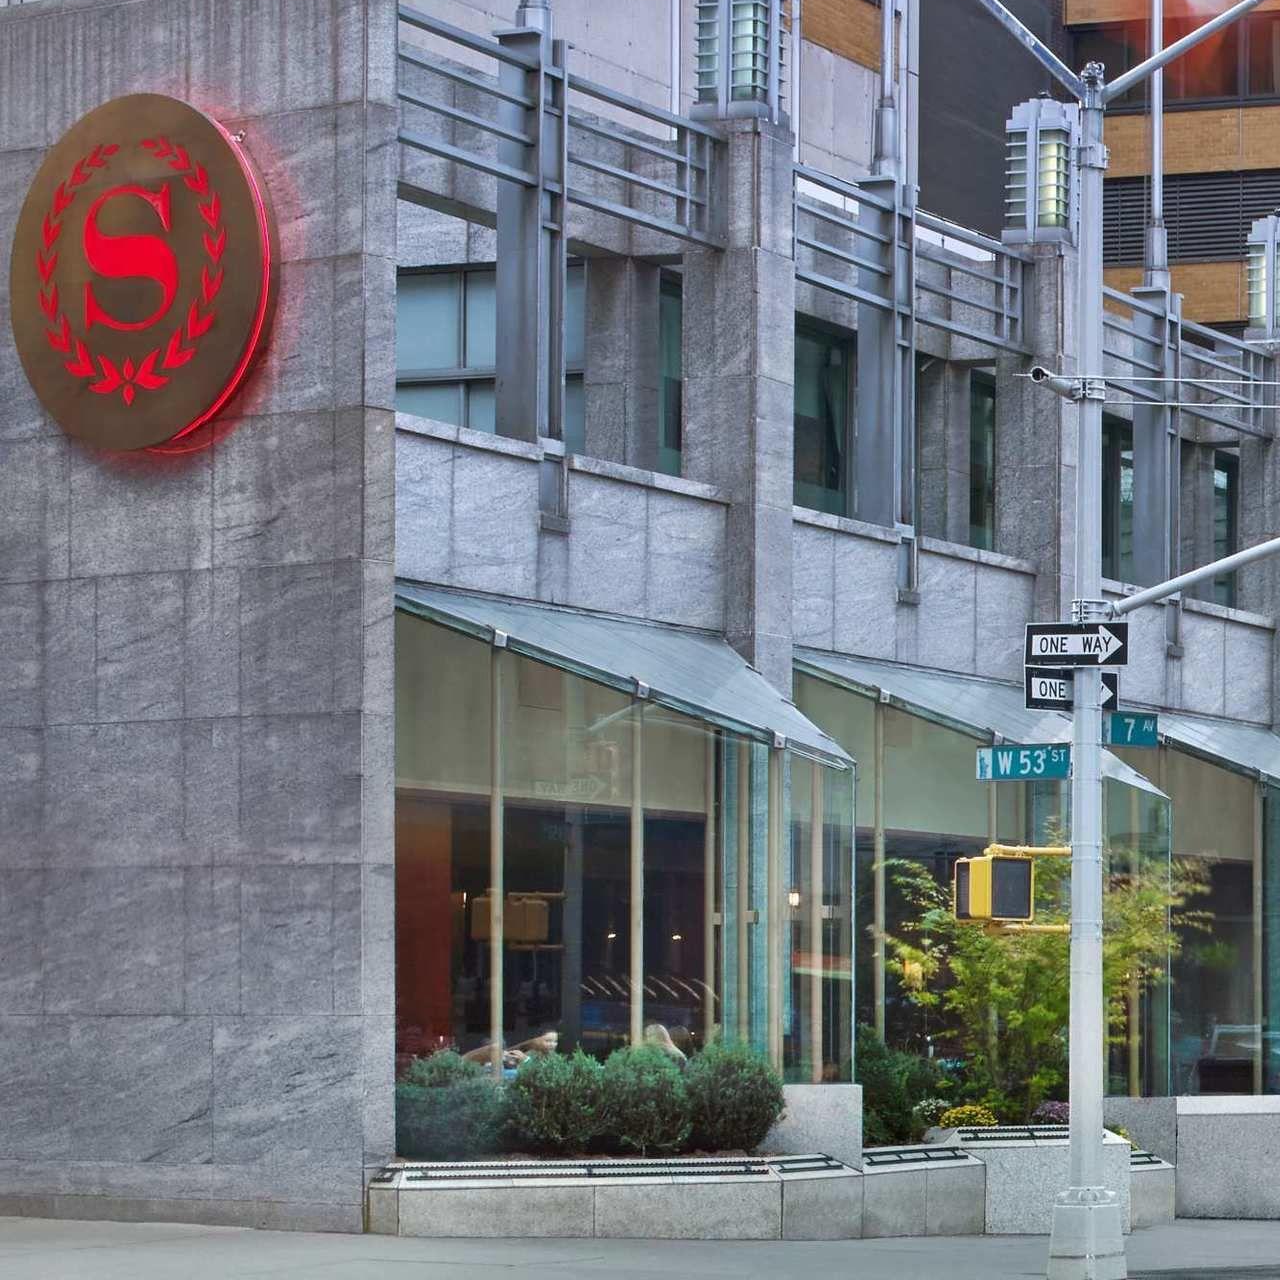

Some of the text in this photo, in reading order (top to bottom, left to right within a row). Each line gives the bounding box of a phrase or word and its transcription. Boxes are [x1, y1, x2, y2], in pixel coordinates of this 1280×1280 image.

[82, 182, 181, 333] S
[1039, 636, 1112, 653] ONE WAY
[1039, 681, 1066, 698] ONE
[1124, 718, 1154, 742] 7 AV
[997, 751, 1013, 775] W
[1051, 750, 1067, 762] ST
